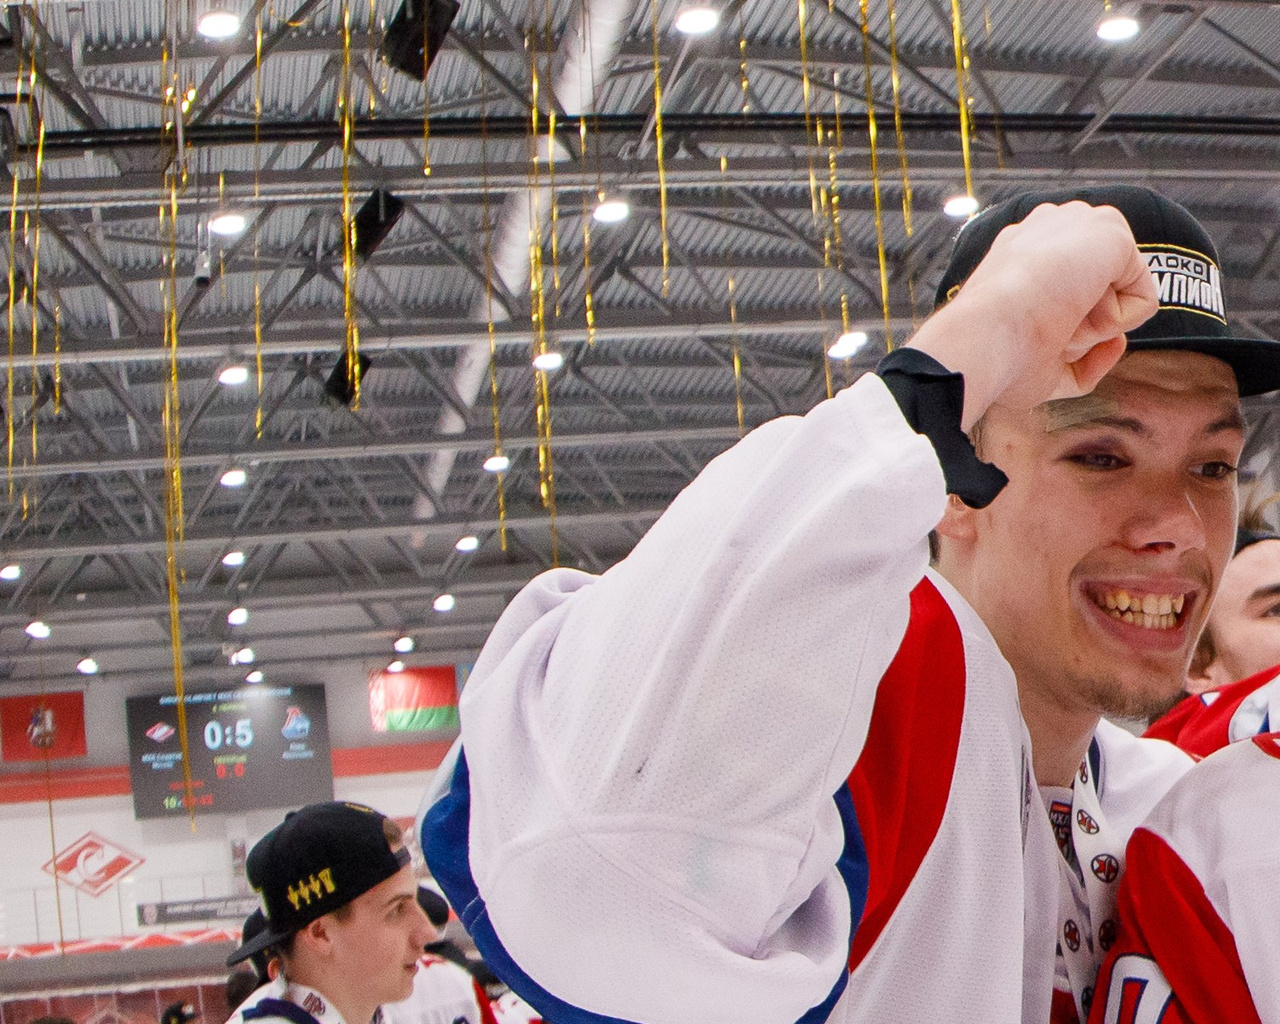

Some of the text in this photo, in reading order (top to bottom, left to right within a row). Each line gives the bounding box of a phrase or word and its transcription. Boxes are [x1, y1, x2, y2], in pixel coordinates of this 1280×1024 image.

[1148, 254, 1204, 276] ЛОКО
[1151, 264, 1226, 319] МПИОН
[203, 718, 254, 750] 0:5
